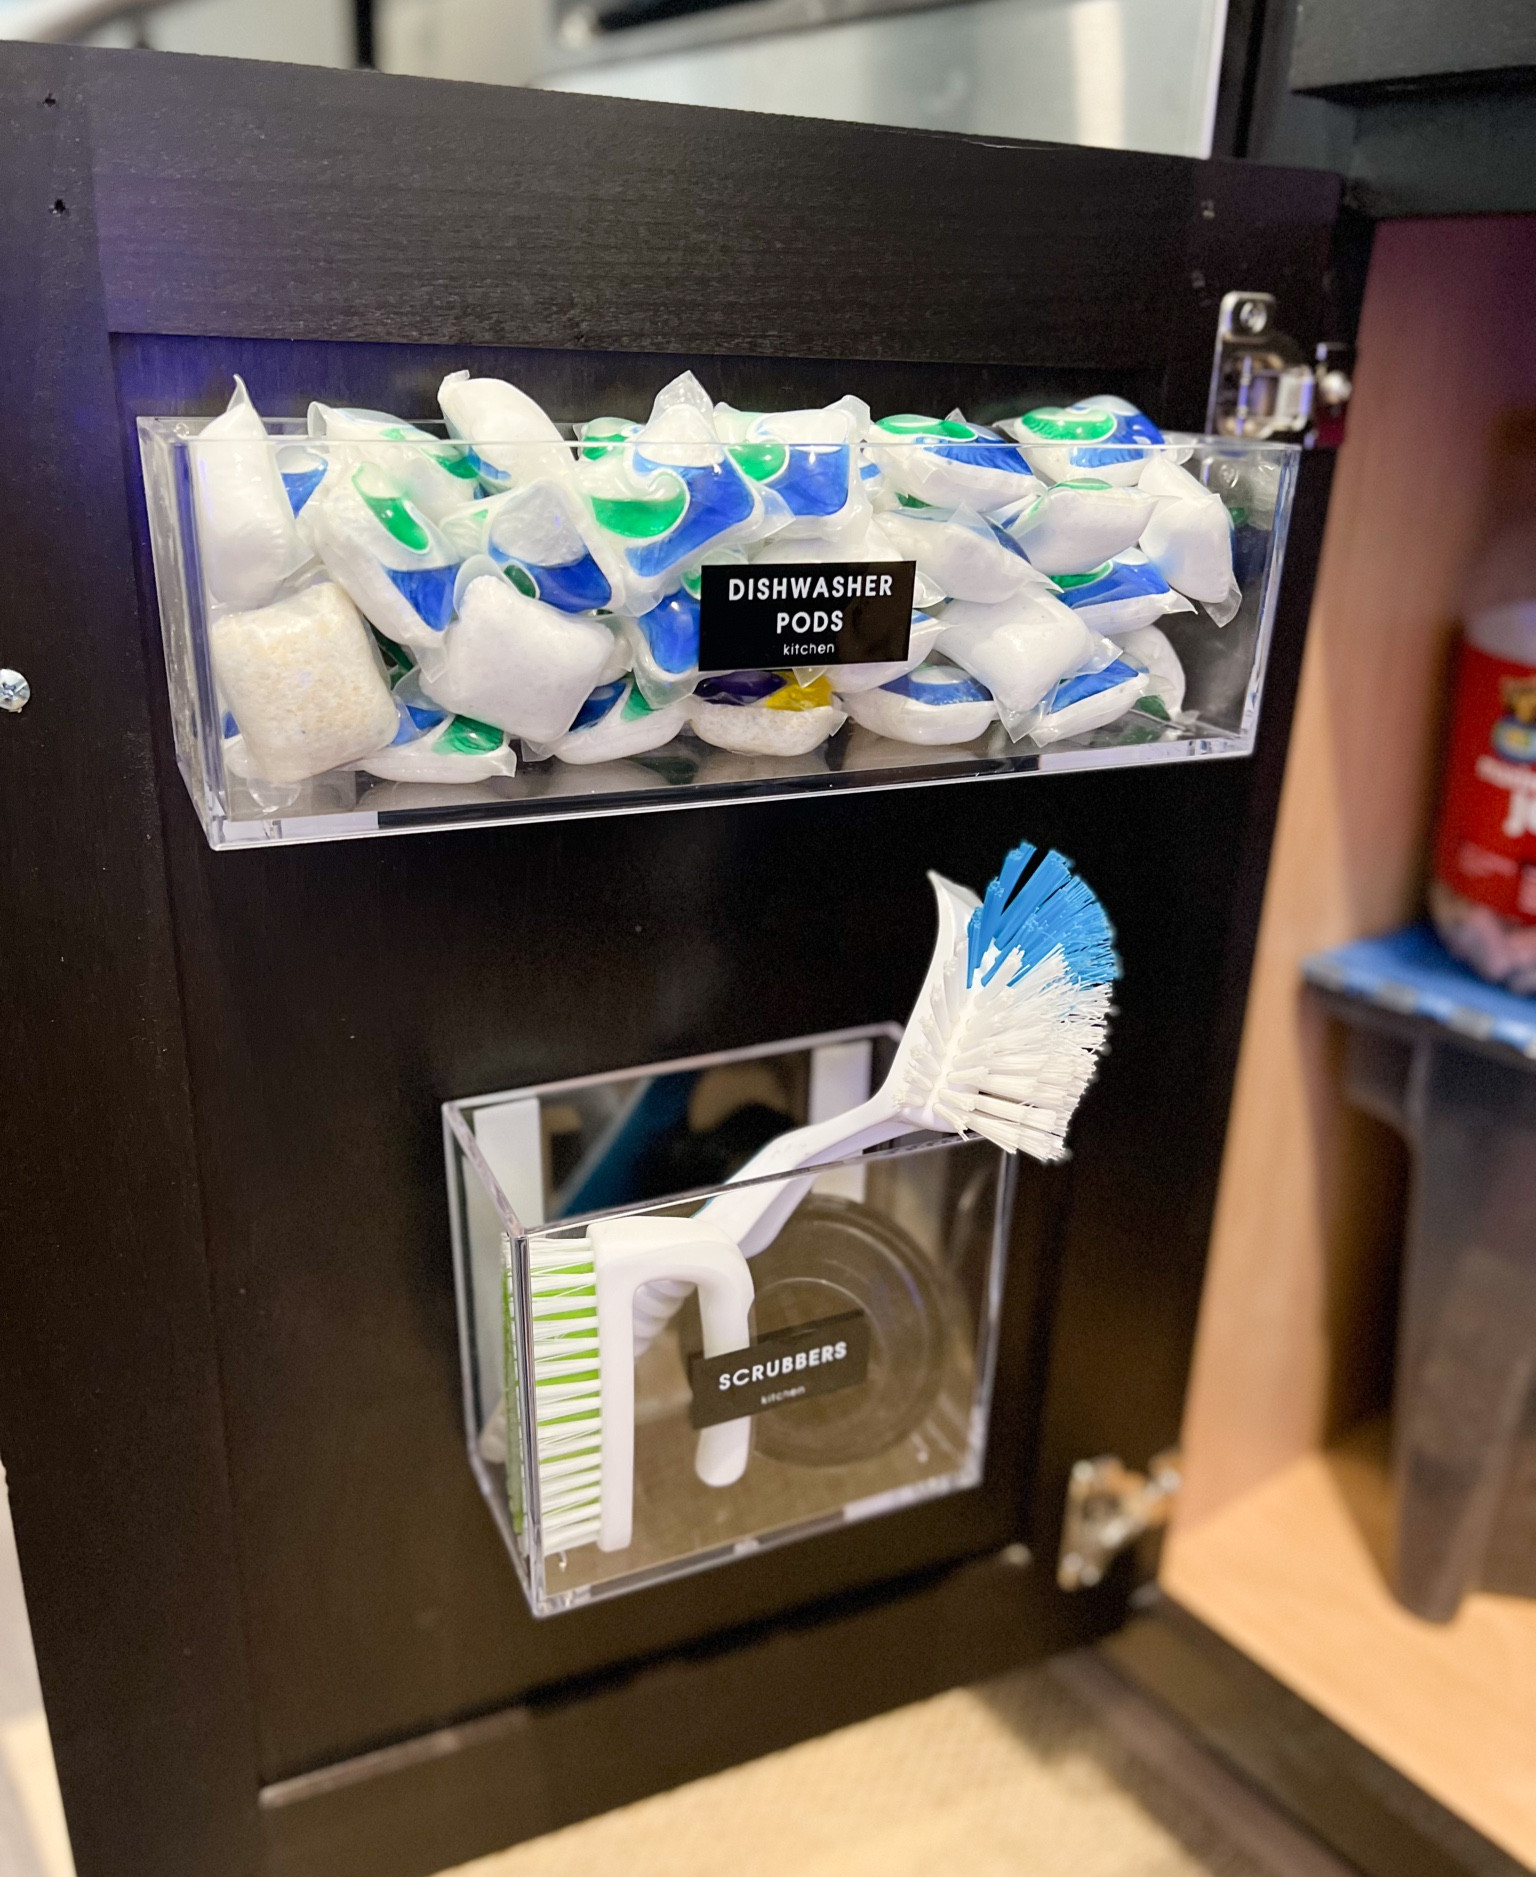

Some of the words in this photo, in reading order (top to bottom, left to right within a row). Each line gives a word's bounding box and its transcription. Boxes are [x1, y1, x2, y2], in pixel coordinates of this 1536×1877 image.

[728, 575, 894, 601] DISHWASHER
[776, 610, 844, 634] PODS
[783, 642, 835, 656] kitchen
[718, 1341, 848, 1391] SCRUBBERS
[760, 1385, 806, 1405] kitchen
